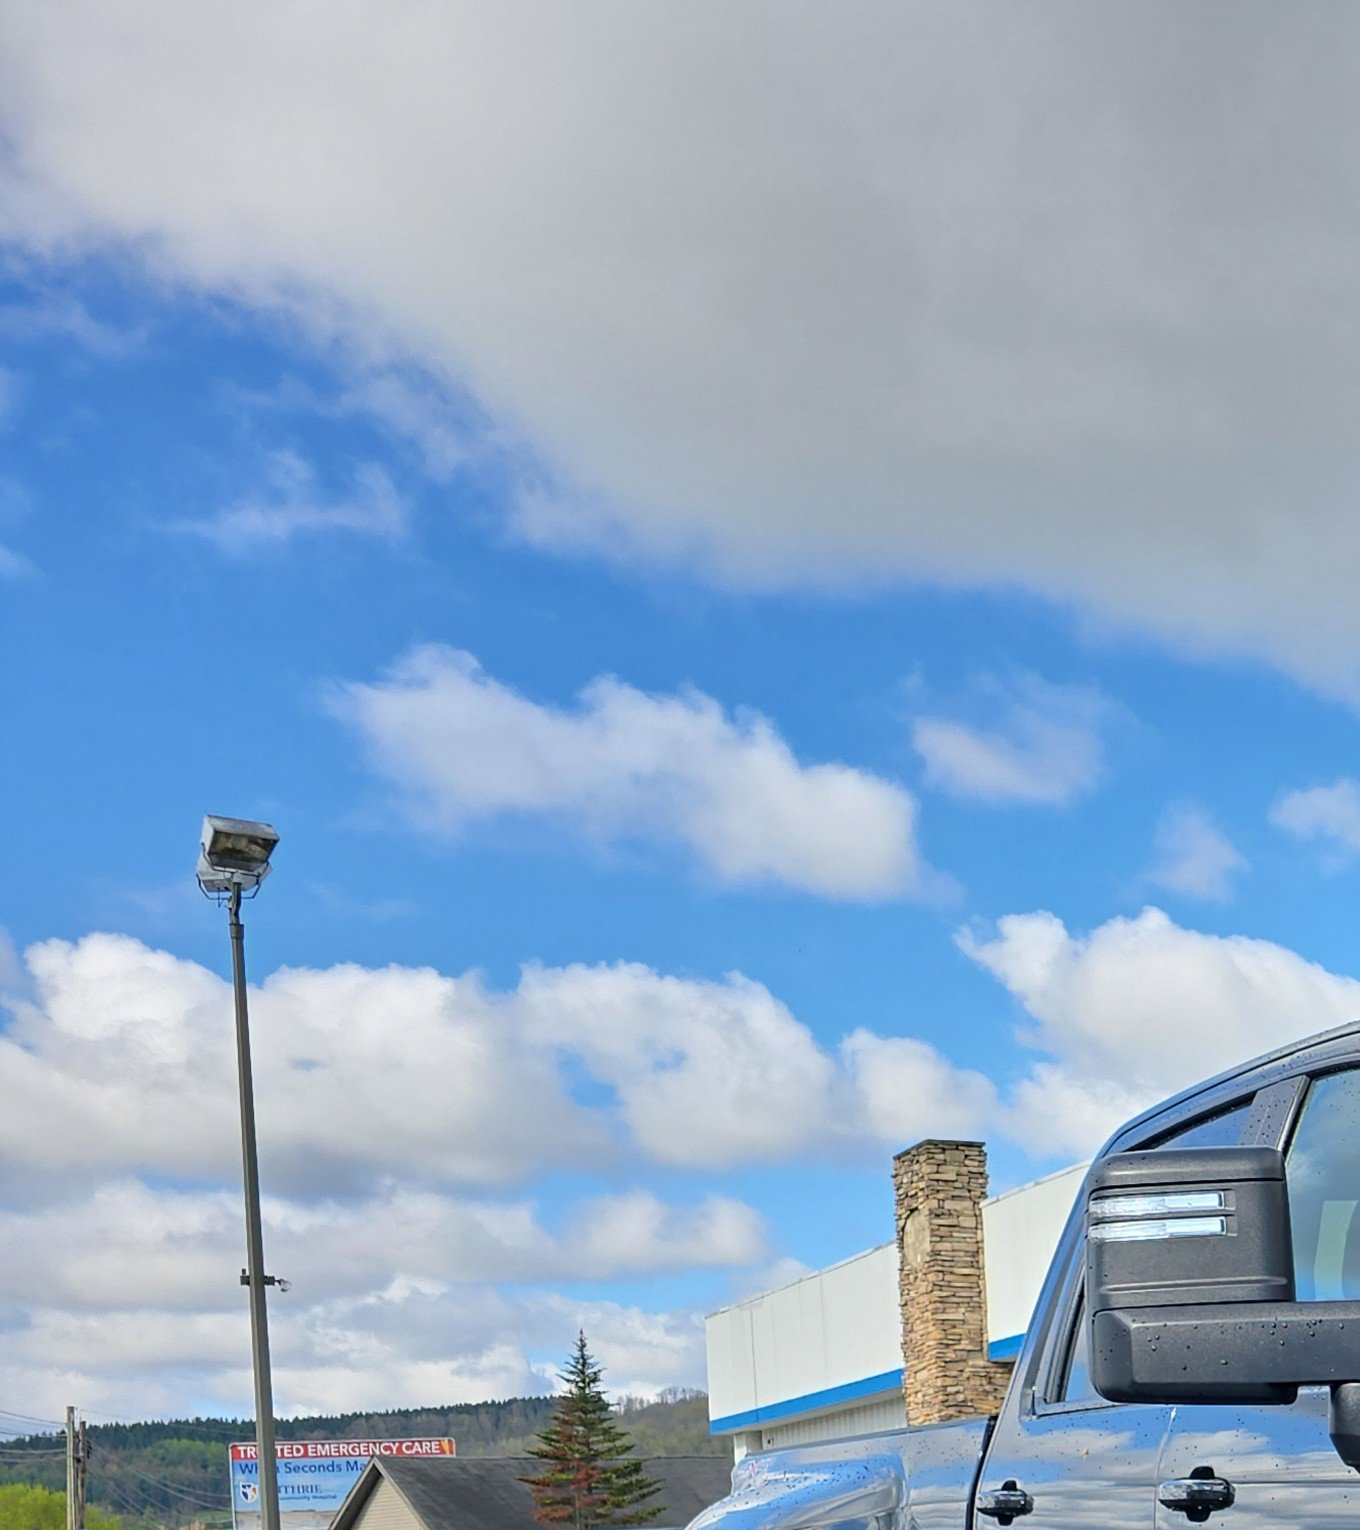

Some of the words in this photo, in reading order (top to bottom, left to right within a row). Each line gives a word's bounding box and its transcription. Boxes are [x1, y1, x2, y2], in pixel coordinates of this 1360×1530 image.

[238, 1444, 304, 1459] TRTED
[307, 1442, 399, 1457] EMERGENCY
[402, 1441, 441, 1455] CARE
[284, 1461, 342, 1474] Seconds
